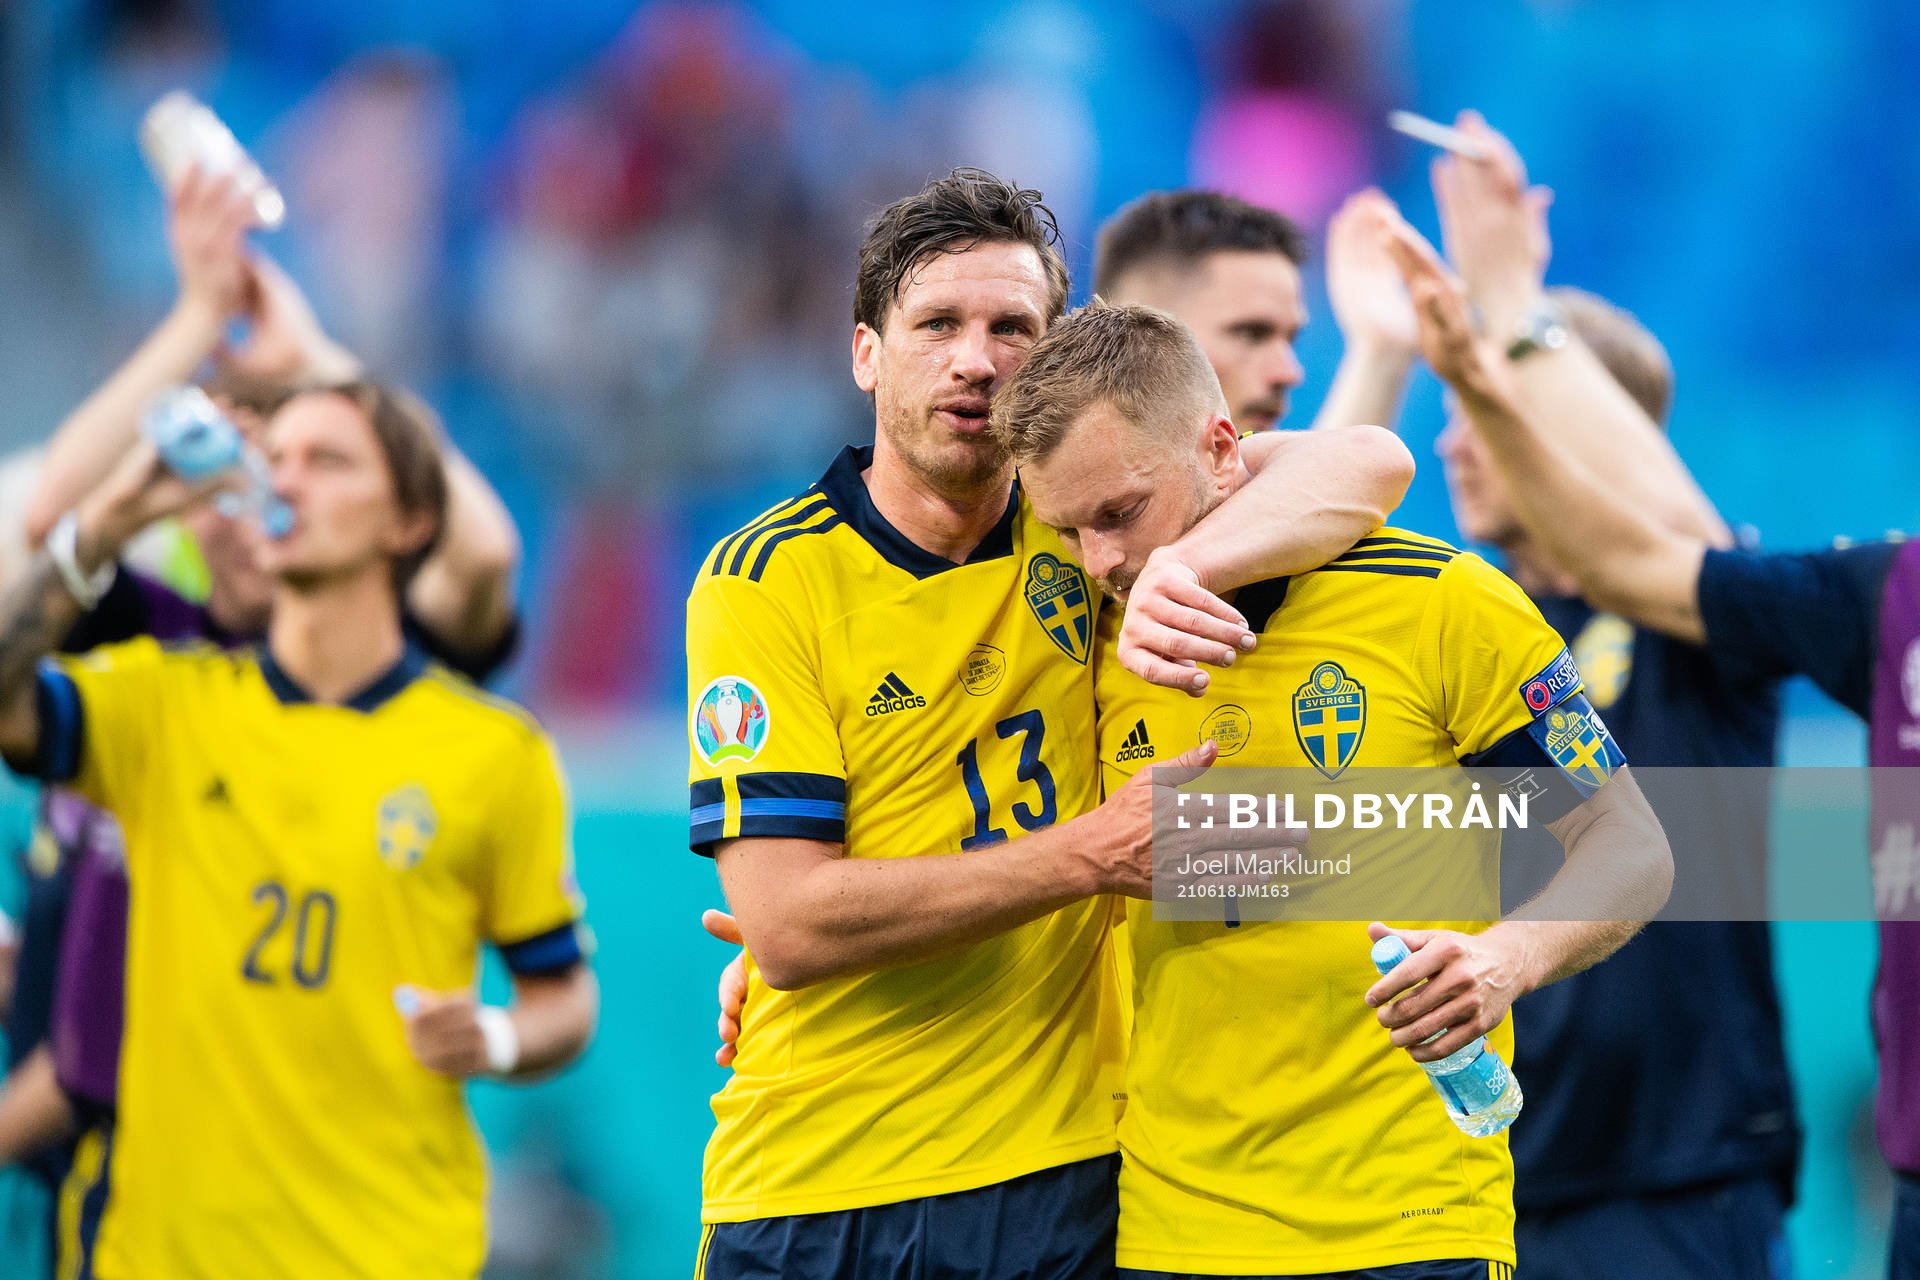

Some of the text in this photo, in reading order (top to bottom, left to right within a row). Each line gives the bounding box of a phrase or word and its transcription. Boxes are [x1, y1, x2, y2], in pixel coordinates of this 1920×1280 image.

[1036, 580, 1073, 602] SVERIGE
[865, 695, 927, 717] adidas
[1305, 695, 1353, 708] SVERIGE
[1554, 721, 1584, 752] SVERIGE
[1116, 744, 1155, 763] adidas
[956, 709, 1058, 853] 13
[240, 880, 337, 990] 20
[1401, 1207, 1445, 1219] AEROREADY
